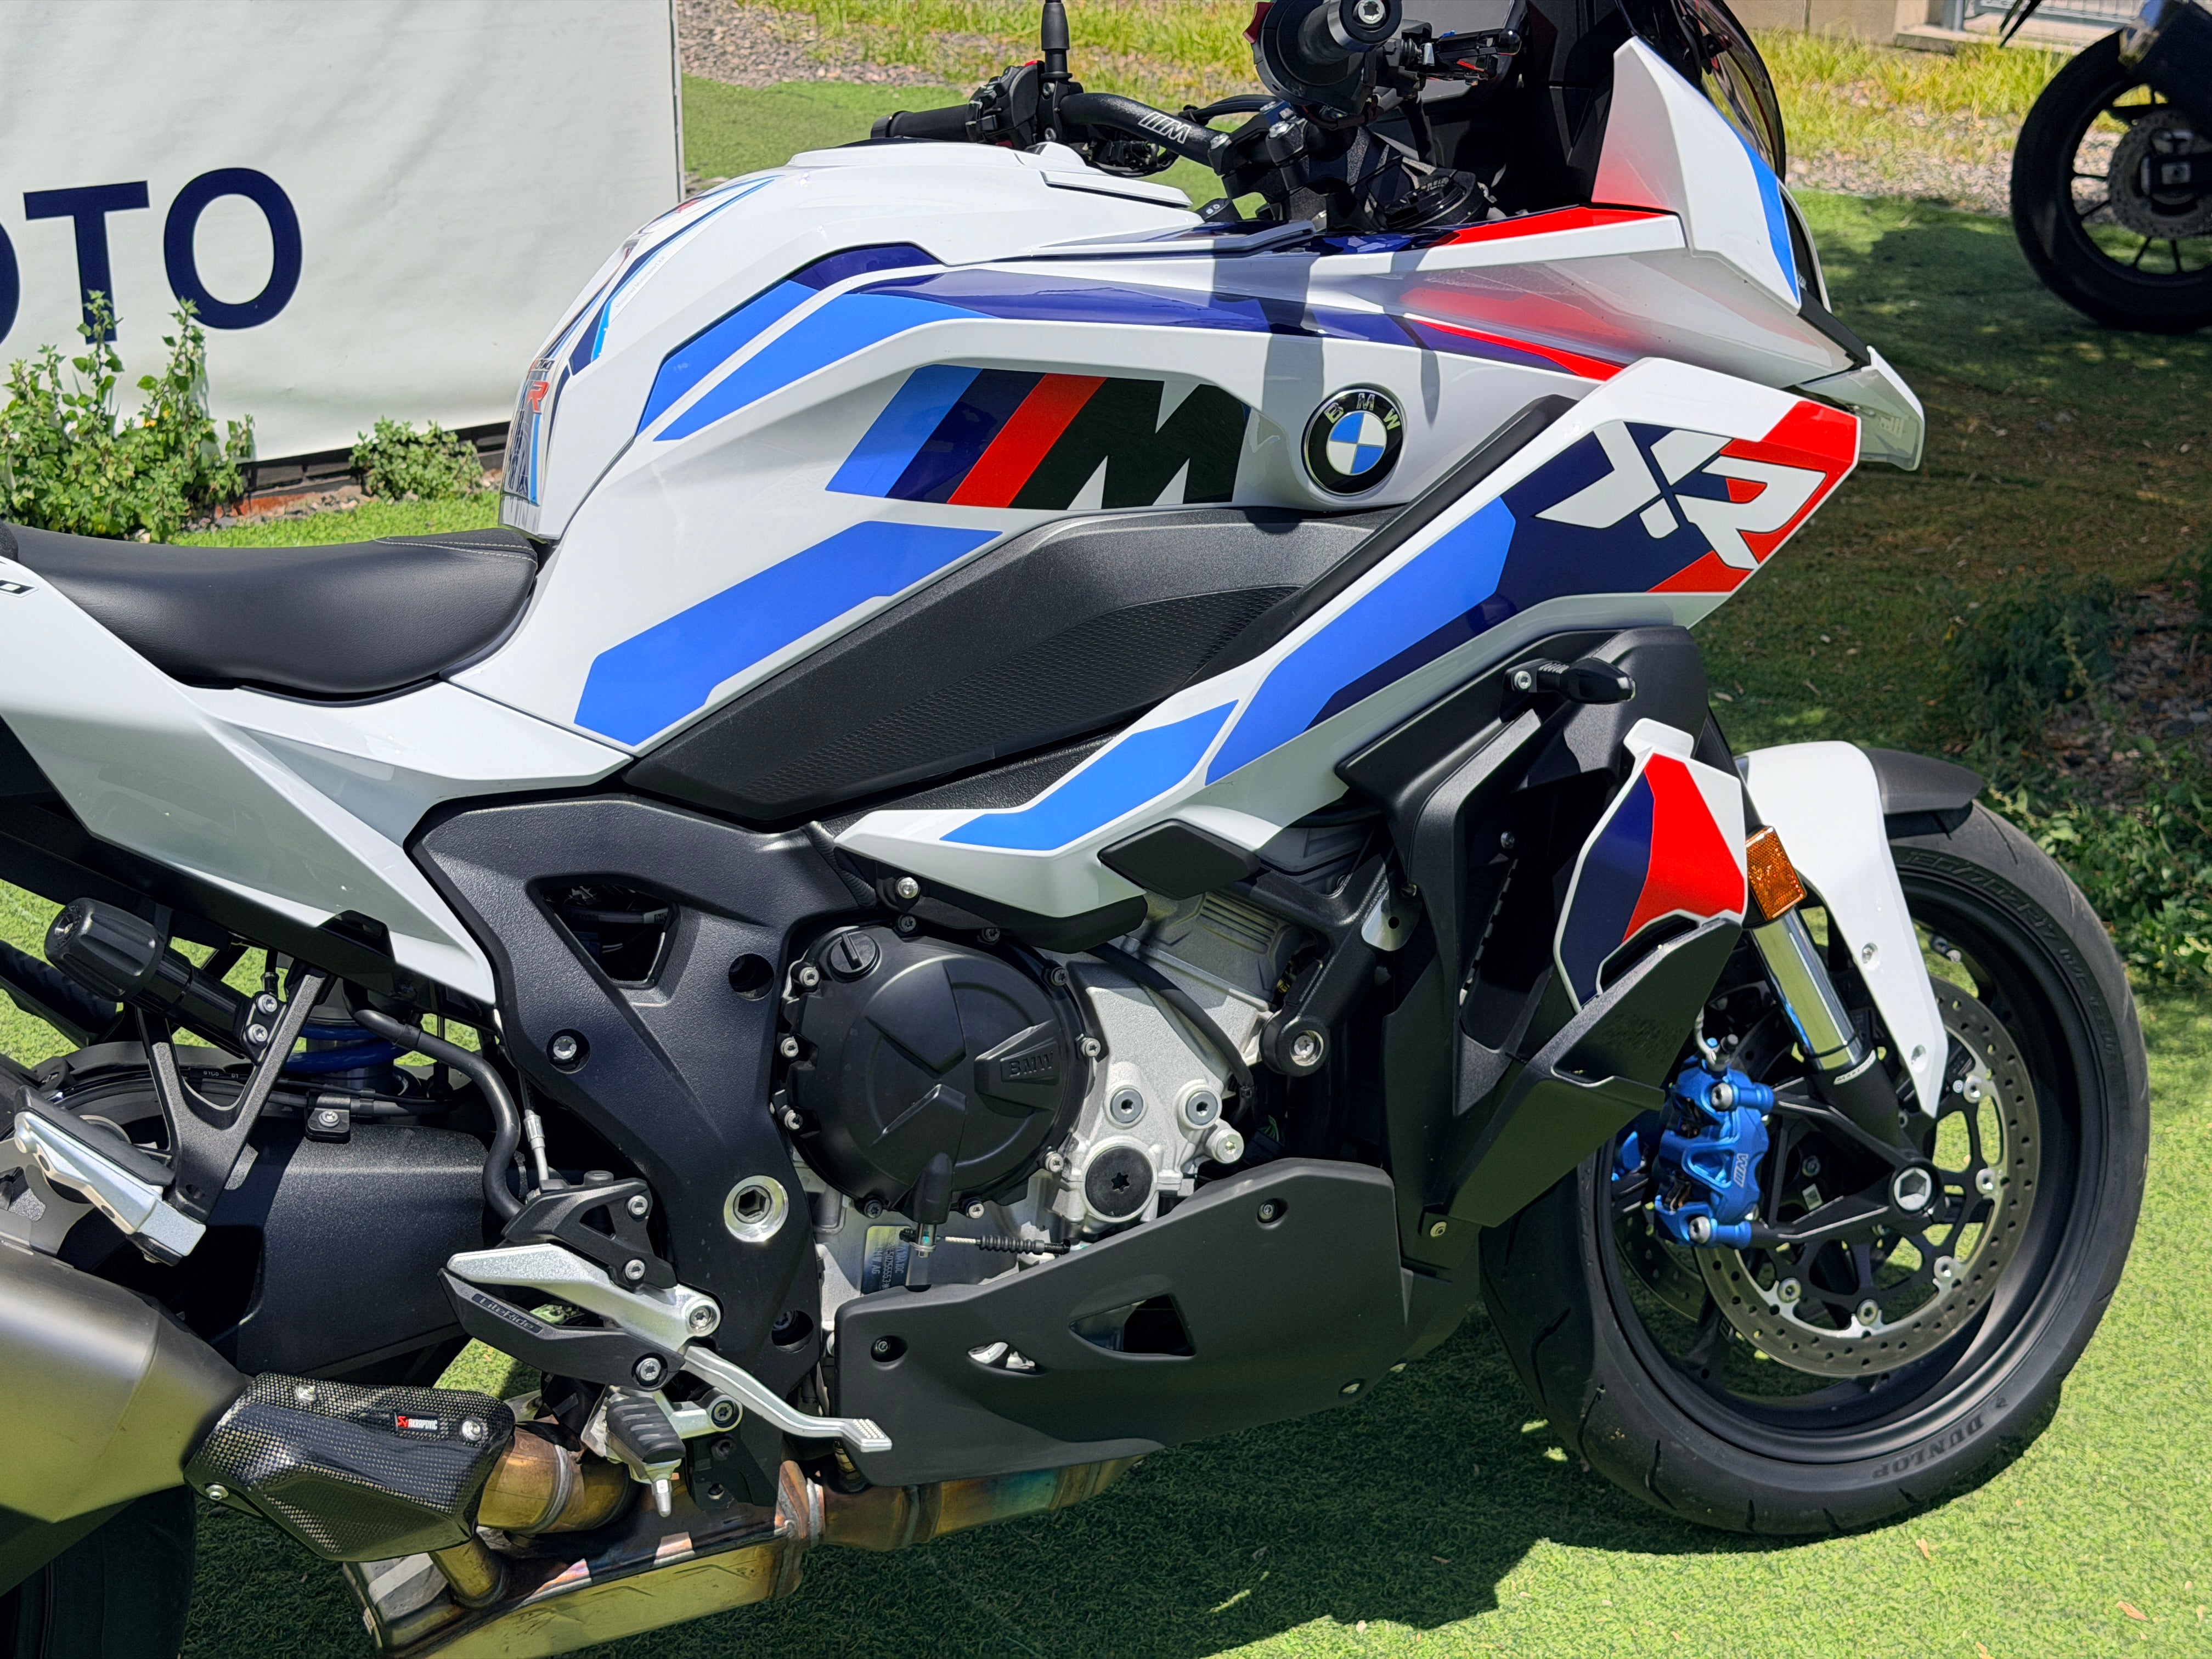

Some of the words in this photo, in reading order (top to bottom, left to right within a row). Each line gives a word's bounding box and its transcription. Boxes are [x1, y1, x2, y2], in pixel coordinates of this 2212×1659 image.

[0, 167, 302, 346] TO
[1324, 393, 1401, 431] BMW
[1534, 420, 1827, 571] XR
[1009, 1050, 1054, 1077] BMW
[479, 1297, 534, 1330] LiteRide
[1872, 1414, 1984, 1478] DUNLOP
